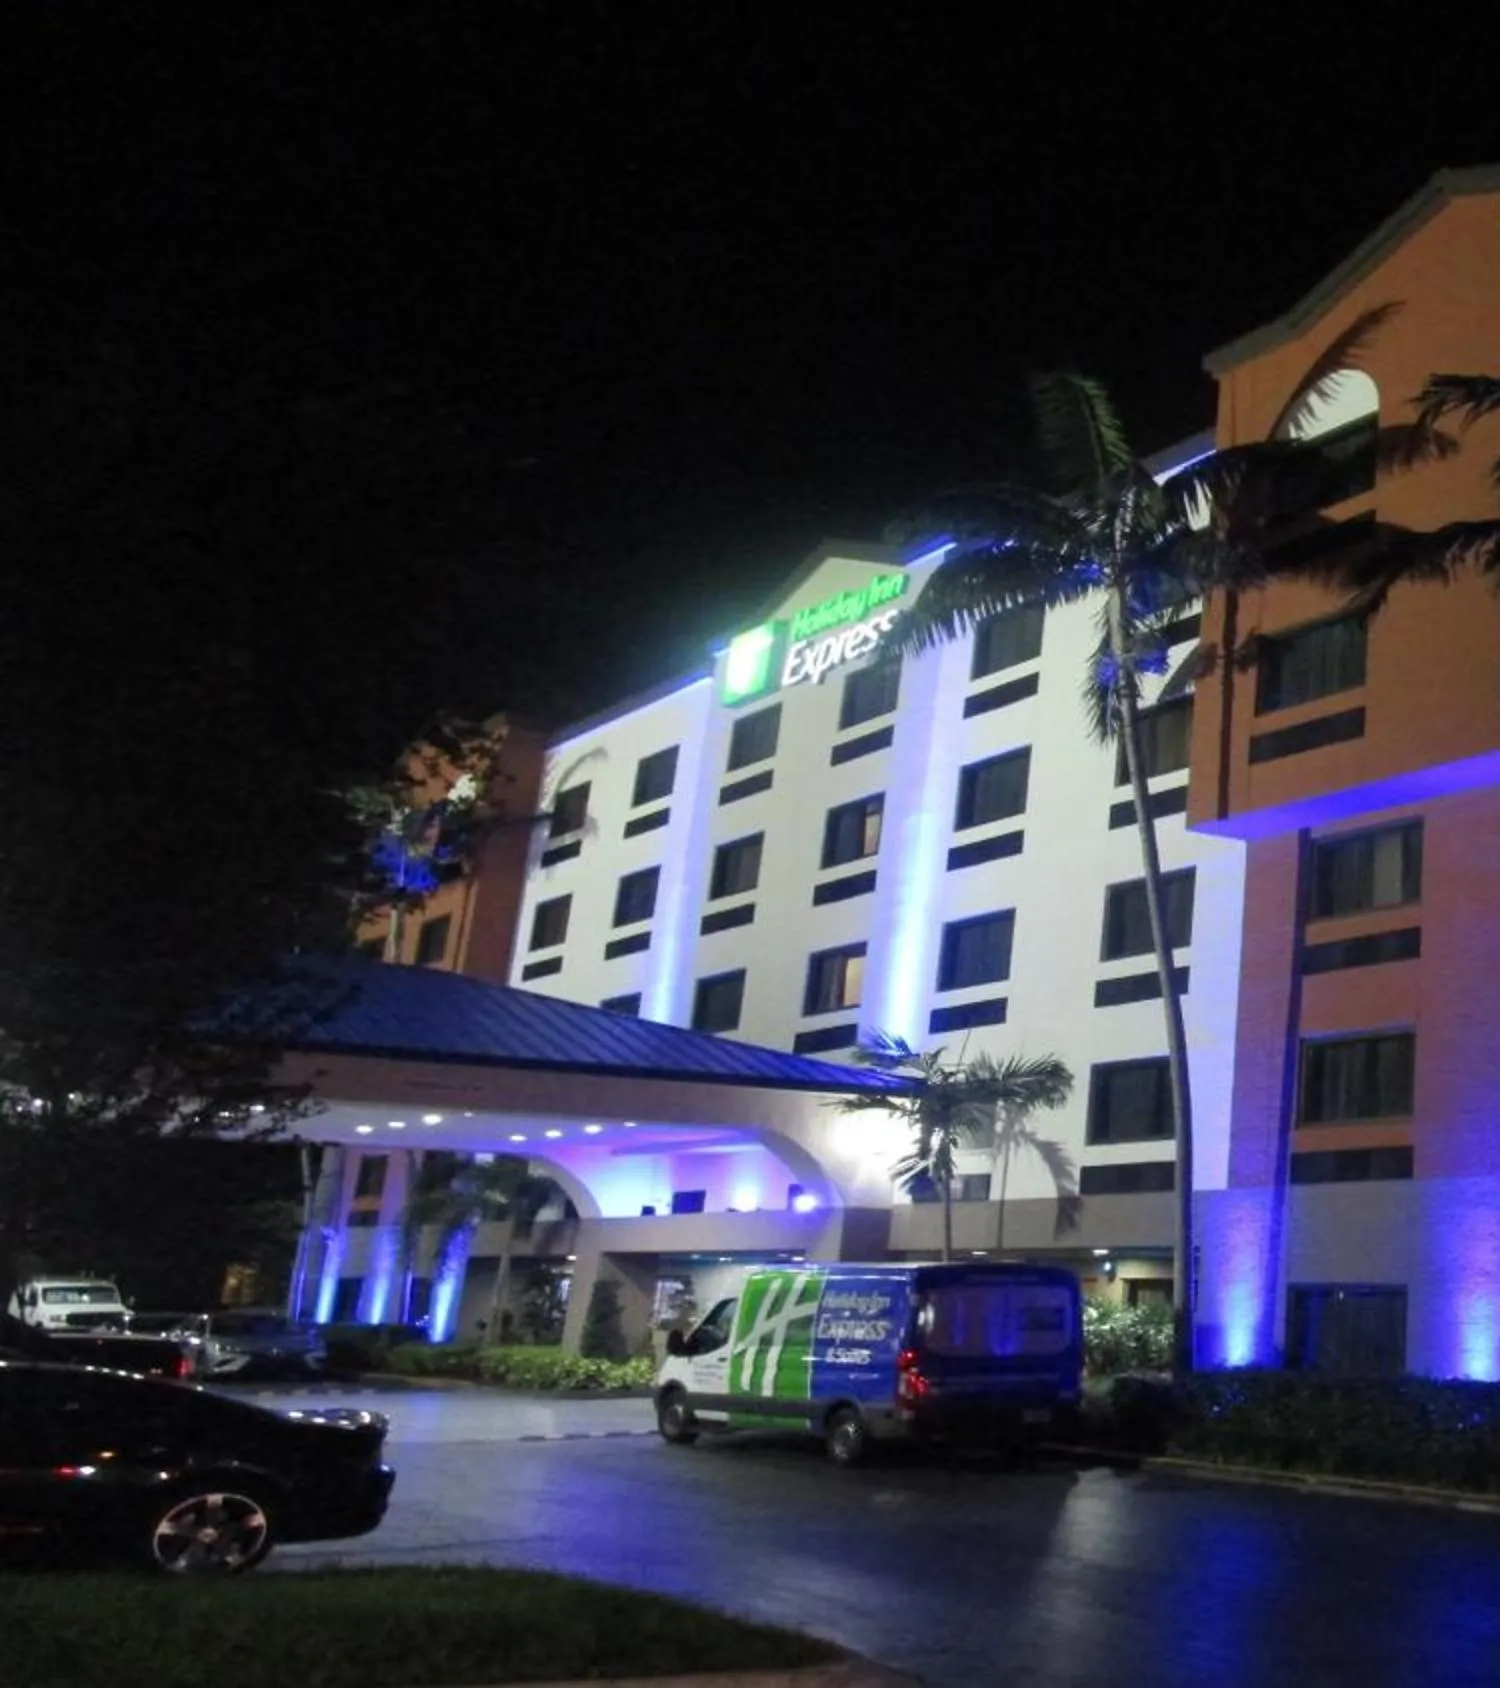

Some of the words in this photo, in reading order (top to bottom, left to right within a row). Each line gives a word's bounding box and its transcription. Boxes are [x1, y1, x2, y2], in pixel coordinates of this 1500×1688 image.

[791, 590, 867, 642] Holiday
[867, 574, 903, 608] Inn
[818, 1313, 891, 1346] Express
